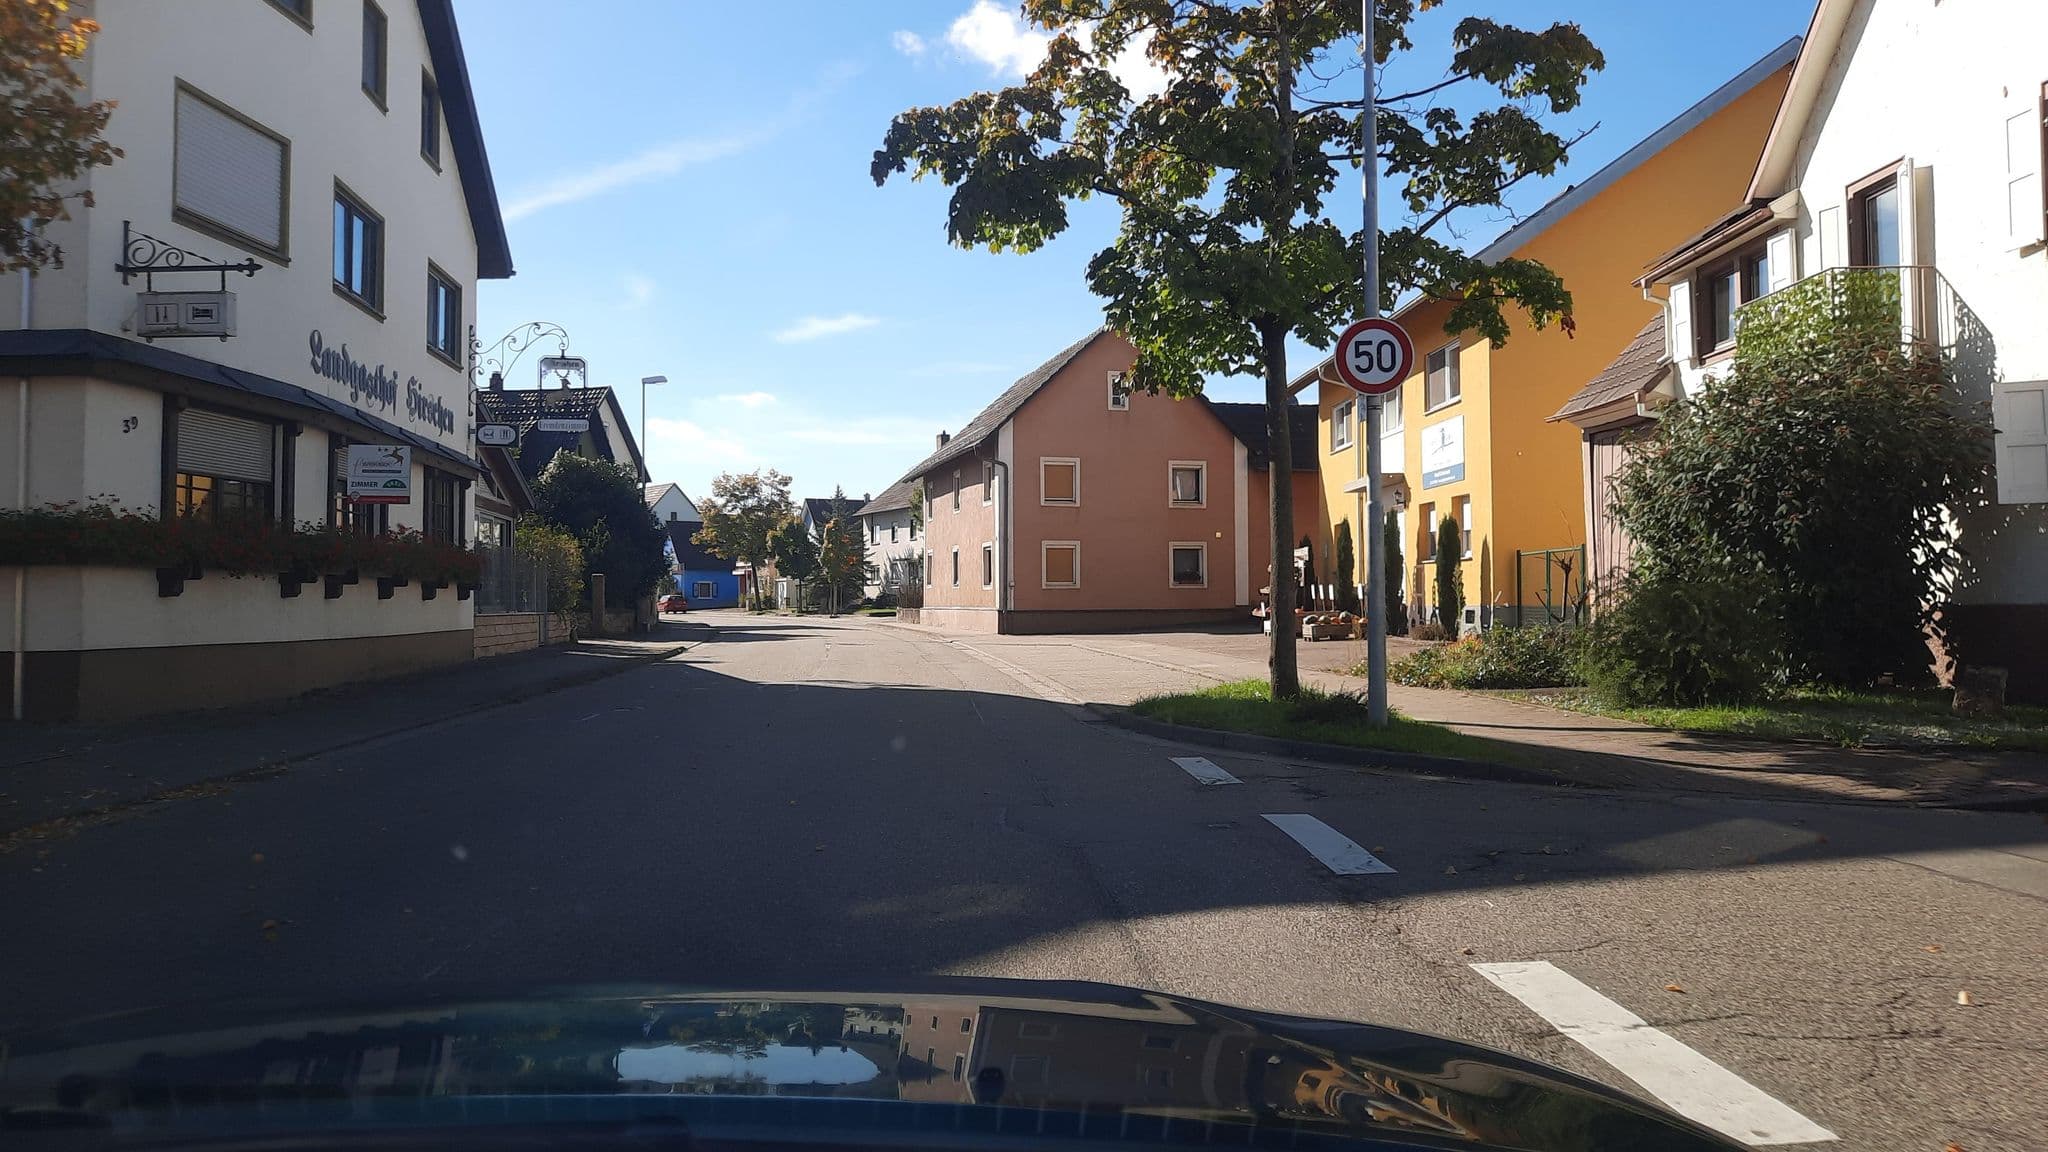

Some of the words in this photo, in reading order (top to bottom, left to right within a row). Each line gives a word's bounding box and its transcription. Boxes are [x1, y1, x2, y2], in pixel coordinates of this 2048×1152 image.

[1354, 339, 1396, 374] 50
[309, 330, 398, 416] Landgasthof
[406, 376, 454, 436] Hirschen
[122, 416, 139, 434] 39
